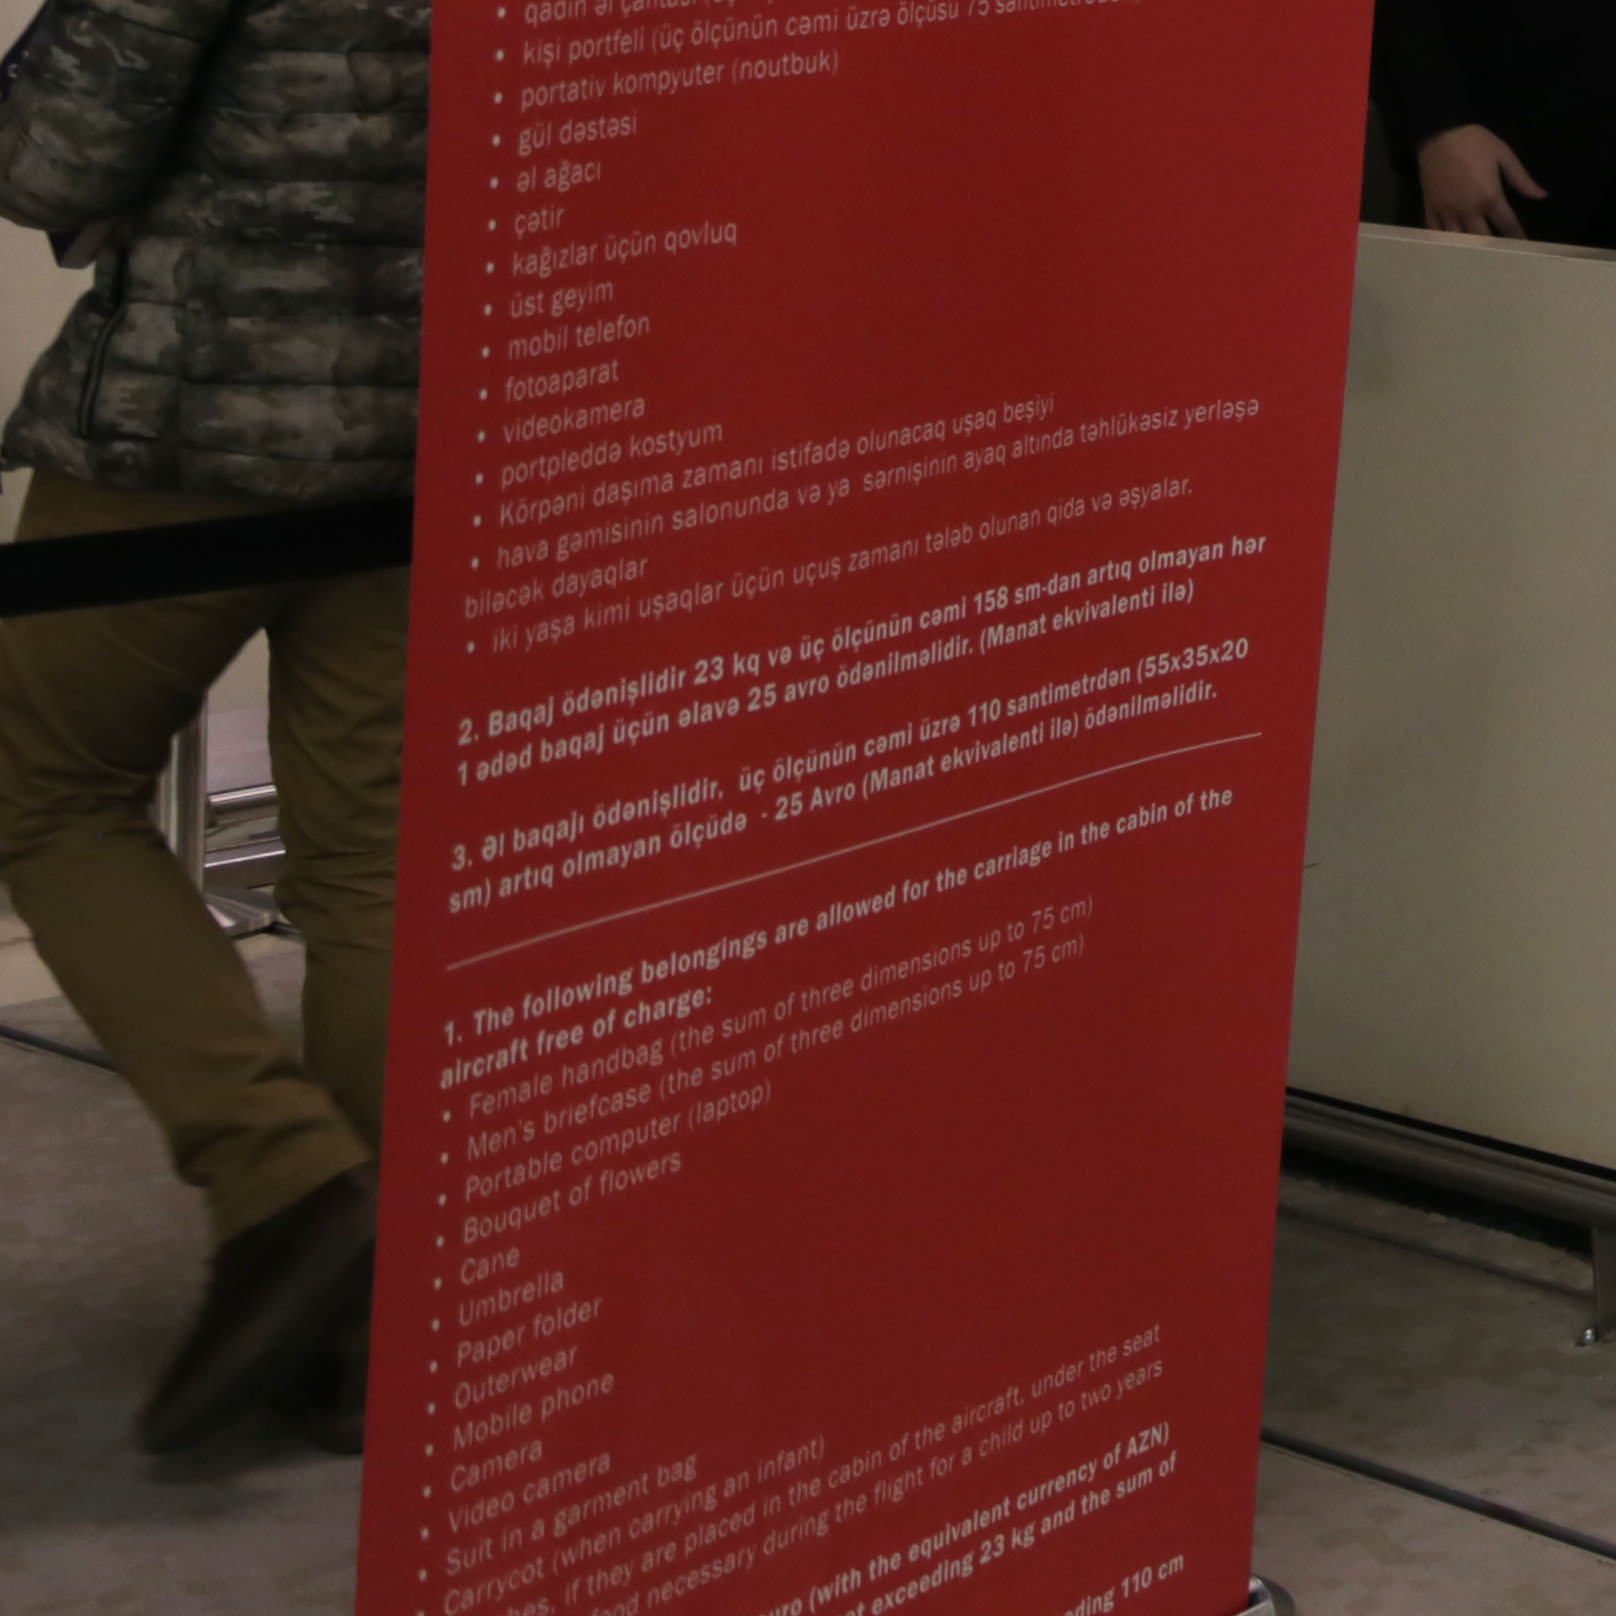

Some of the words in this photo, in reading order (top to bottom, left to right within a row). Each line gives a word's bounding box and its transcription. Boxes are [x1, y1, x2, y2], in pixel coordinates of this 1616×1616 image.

[521, 78, 605, 113] portativ
[613, 63, 725, 96] kompyuter
[732, 49, 838, 83] (noutbuk)
[517, 122, 552, 157] gül
[559, 116, 637, 145] dəstəsi
[516, 166, 536, 192] əl
[543, 160, 601, 193] ağacı
[512, 242, 597, 279] kağızlar
[605, 231, 656, 264] üçün
[664, 221, 737, 255] qovluq
[514, 208, 565, 240] çətir
[510, 291, 544, 319] üst
[550, 281, 613, 318] geyim
[508, 325, 568, 360] mobil
[575, 314, 650, 348] telefon
[505, 359, 619, 401] fotoaparat
[503, 397, 645, 443] videokamera
[501, 440, 622, 491] portpleddə
[629, 424, 723, 457] kostyum
[458, 718, 479, 746] 2.
[488, 696, 554, 737] Baqaj
[561, 666, 686, 717] ödənişlidir
[693, 656, 724, 685] 23
[732, 652, 760, 677] kq
[767, 646, 792, 667] və
[799, 635, 825, 662] üç
[831, 613, 913, 652] ölçünün
[919, 596, 966, 630] cəmi
[974, 585, 1009, 614] 158
[1014, 572, 1081, 605] sm-dan
[1087, 560, 1132, 586] artıq
[1138, 542, 1224, 574] olmayan
[1231, 535, 1267, 557] hər
[458, 761, 468, 786] 1
[476, 743, 532, 781] ədəd
[540, 723, 604, 763] baqaj
[612, 711, 670, 746] üçün
[678, 697, 740, 728] əlavə
[747, 682, 777, 712] 25
[784, 675, 830, 703] avro
[980, 613, 1047, 655] (Manat
[1052, 584, 1155, 631] ekvivalenti
[452, 844, 473, 871] 3.
[481, 832, 505, 862] Əl
[512, 811, 584, 852] baqajı
[739, 767, 766, 794] üç
[772, 742, 857, 783] ölçünün
[864, 722, 913, 757] cəmi
[919, 715, 961, 742] üzrə
[968, 698, 1001, 727] 110
[1007, 667, 1131, 717] santimetrdən
[1137, 637, 1249, 684] (55x35x20
[449, 878, 491, 914] sm)
[498, 864, 554, 898] artıq
[562, 835, 661, 878] olmayan
[669, 810, 747, 849] ölçüdə
[774, 791, 803, 821] 25
[810, 782, 856, 811] Avro
[862, 755, 934, 800] (Manat
[940, 721, 1044, 772] ekvivalenti
[444, 1020, 462, 1046] 1.
[473, 1006, 514, 1036] The
[522, 967, 634, 1020] following
[641, 930, 768, 984] belongings
[774, 918, 809, 944] are
[816, 884, 896, 931] allowed
[902, 879, 930, 903] for
[936, 867, 968, 893] the
[973, 840, 1053, 880] carriage
[1058, 831, 1075, 853] in
[1080, 821, 1110, 845] the
[1116, 802, 1168, 834] cabin
[1174, 792, 1194, 817] of
[1199, 788, 1233, 811] the
[440, 1038, 529, 1090] aircraft
[536, 1024, 584, 1056] free
[592, 1008, 616, 1038] of
[623, 986, 712, 1029] charge:
[469, 1074, 553, 1119] Female
[562, 1037, 664, 1088] handbag
[671, 1024, 715, 1057] (the
[721, 1007, 766, 1039] sum
[774, 992, 795, 1021] of
[800, 978, 854, 1012] three
[860, 939, 972, 992] dimensions
[978, 929, 1001, 953] up
[1007, 921, 1025, 942] to
[1032, 906, 1055, 934] 75
[1060, 896, 1092, 924] cm)
[467, 1120, 535, 1161] Men's
[544, 1083, 652, 1134] briefcase
[660, 1067, 704, 1100] (the
[711, 1049, 756, 1081] sum
[764, 1033, 785, 1063] of
[790, 1019, 844, 1054] three
[850, 979, 963, 1033] dimensions
[969, 969, 992, 992] up
[997, 961, 1015, 982] to
[1023, 944, 1046, 973] 75
[1051, 934, 1084, 963] cm)
[465, 1152, 563, 1202] Portable
[571, 1113, 681, 1166] computer
[688, 1080, 771, 1129] (laptop)
[464, 1189, 560, 1245] Bouquet
[568, 1175, 592, 1206] of
[599, 1152, 682, 1196] flowers
[459, 1271, 564, 1327] Umbrella
[460, 1247, 520, 1285] Cane
[457, 1326, 526, 1368] Paper
[533, 1298, 602, 1339] folder
[454, 1346, 578, 1410] Outerwear
[454, 1403, 532, 1450] Mobile
[541, 1373, 614, 1423] phone
[449, 1491, 515, 1533] Video
[522, 1452, 610, 1505] camera
[450, 1439, 543, 1493] Camera
[446, 1537, 493, 1576] Suit
[502, 1528, 522, 1552] in
[531, 1519, 545, 1541] a
[553, 1473, 649, 1538] garment
[657, 1454, 697, 1488] bag
